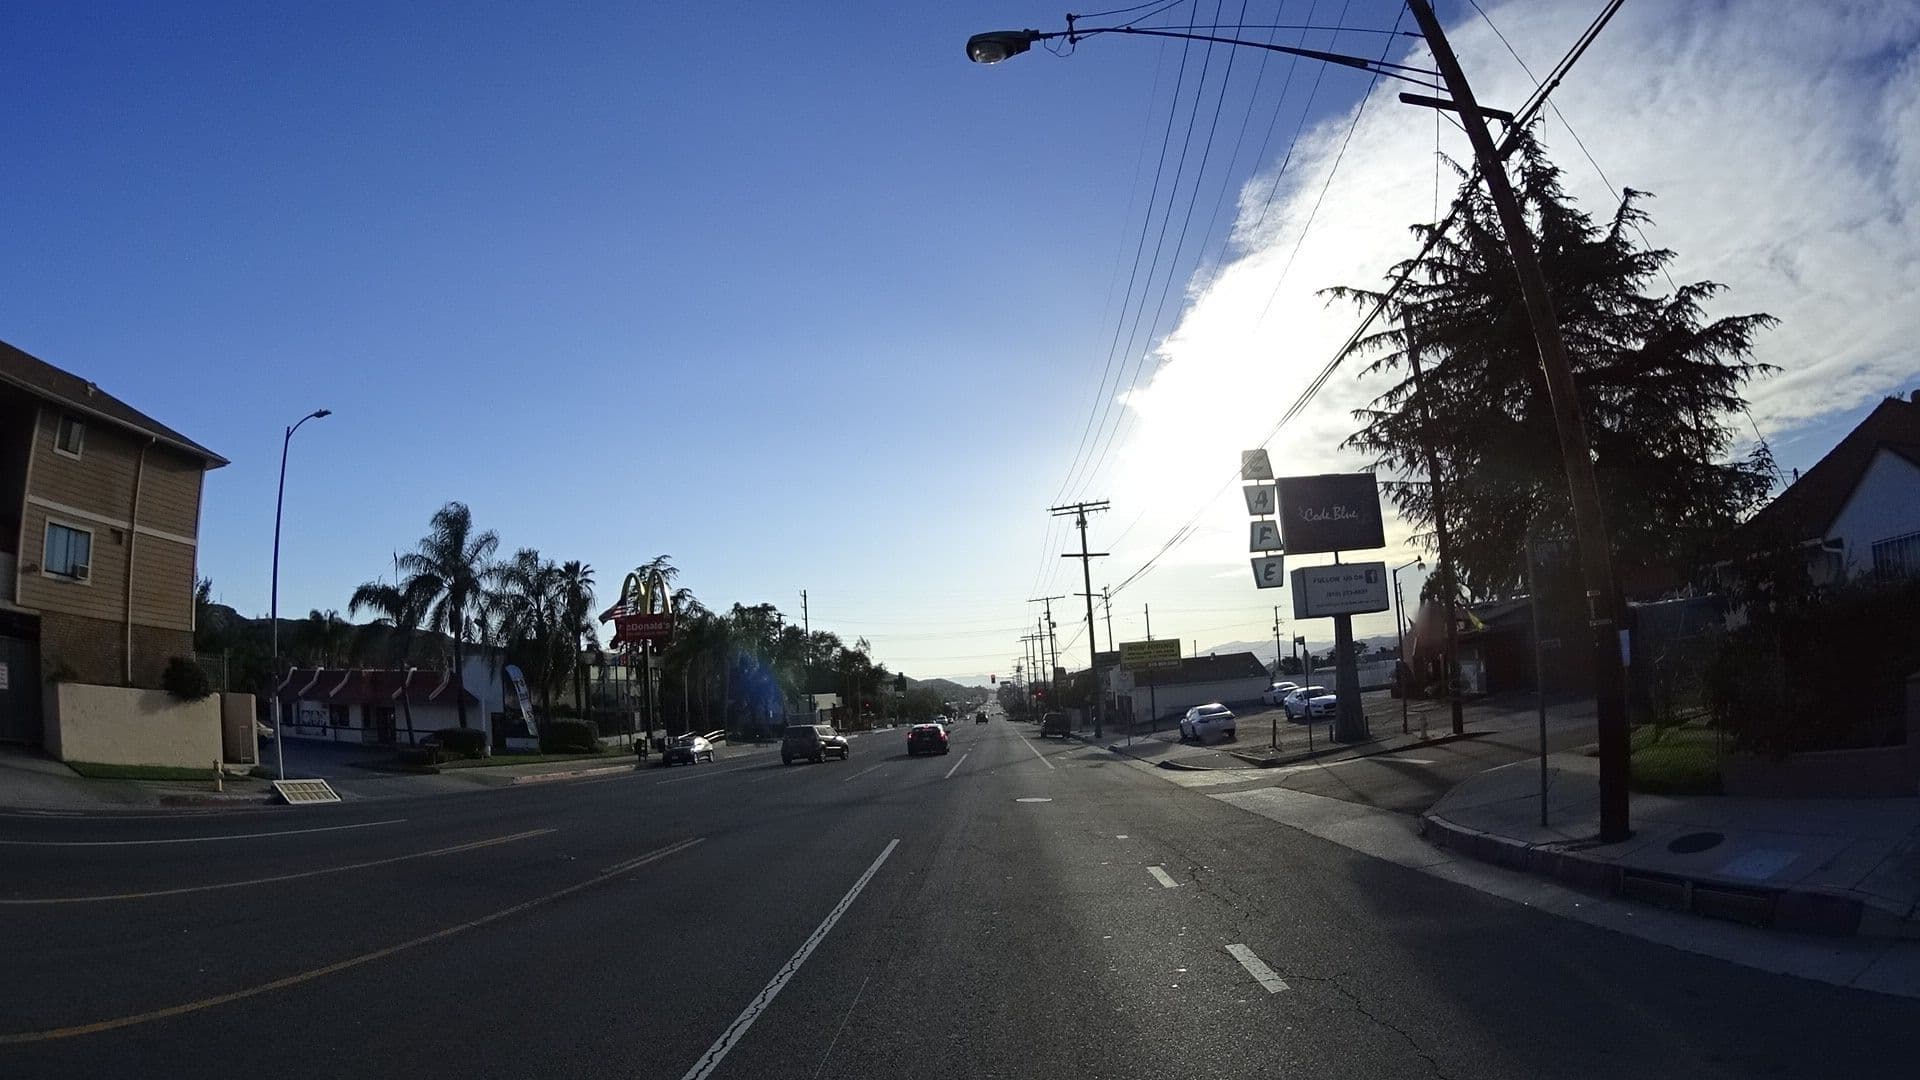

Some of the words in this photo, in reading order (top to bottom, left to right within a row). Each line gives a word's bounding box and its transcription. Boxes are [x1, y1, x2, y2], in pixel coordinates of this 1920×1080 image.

[1303, 506, 1331, 522] Code
[1332, 505, 1358, 521] Blue
[1312, 575, 1340, 584] FOLLOW
